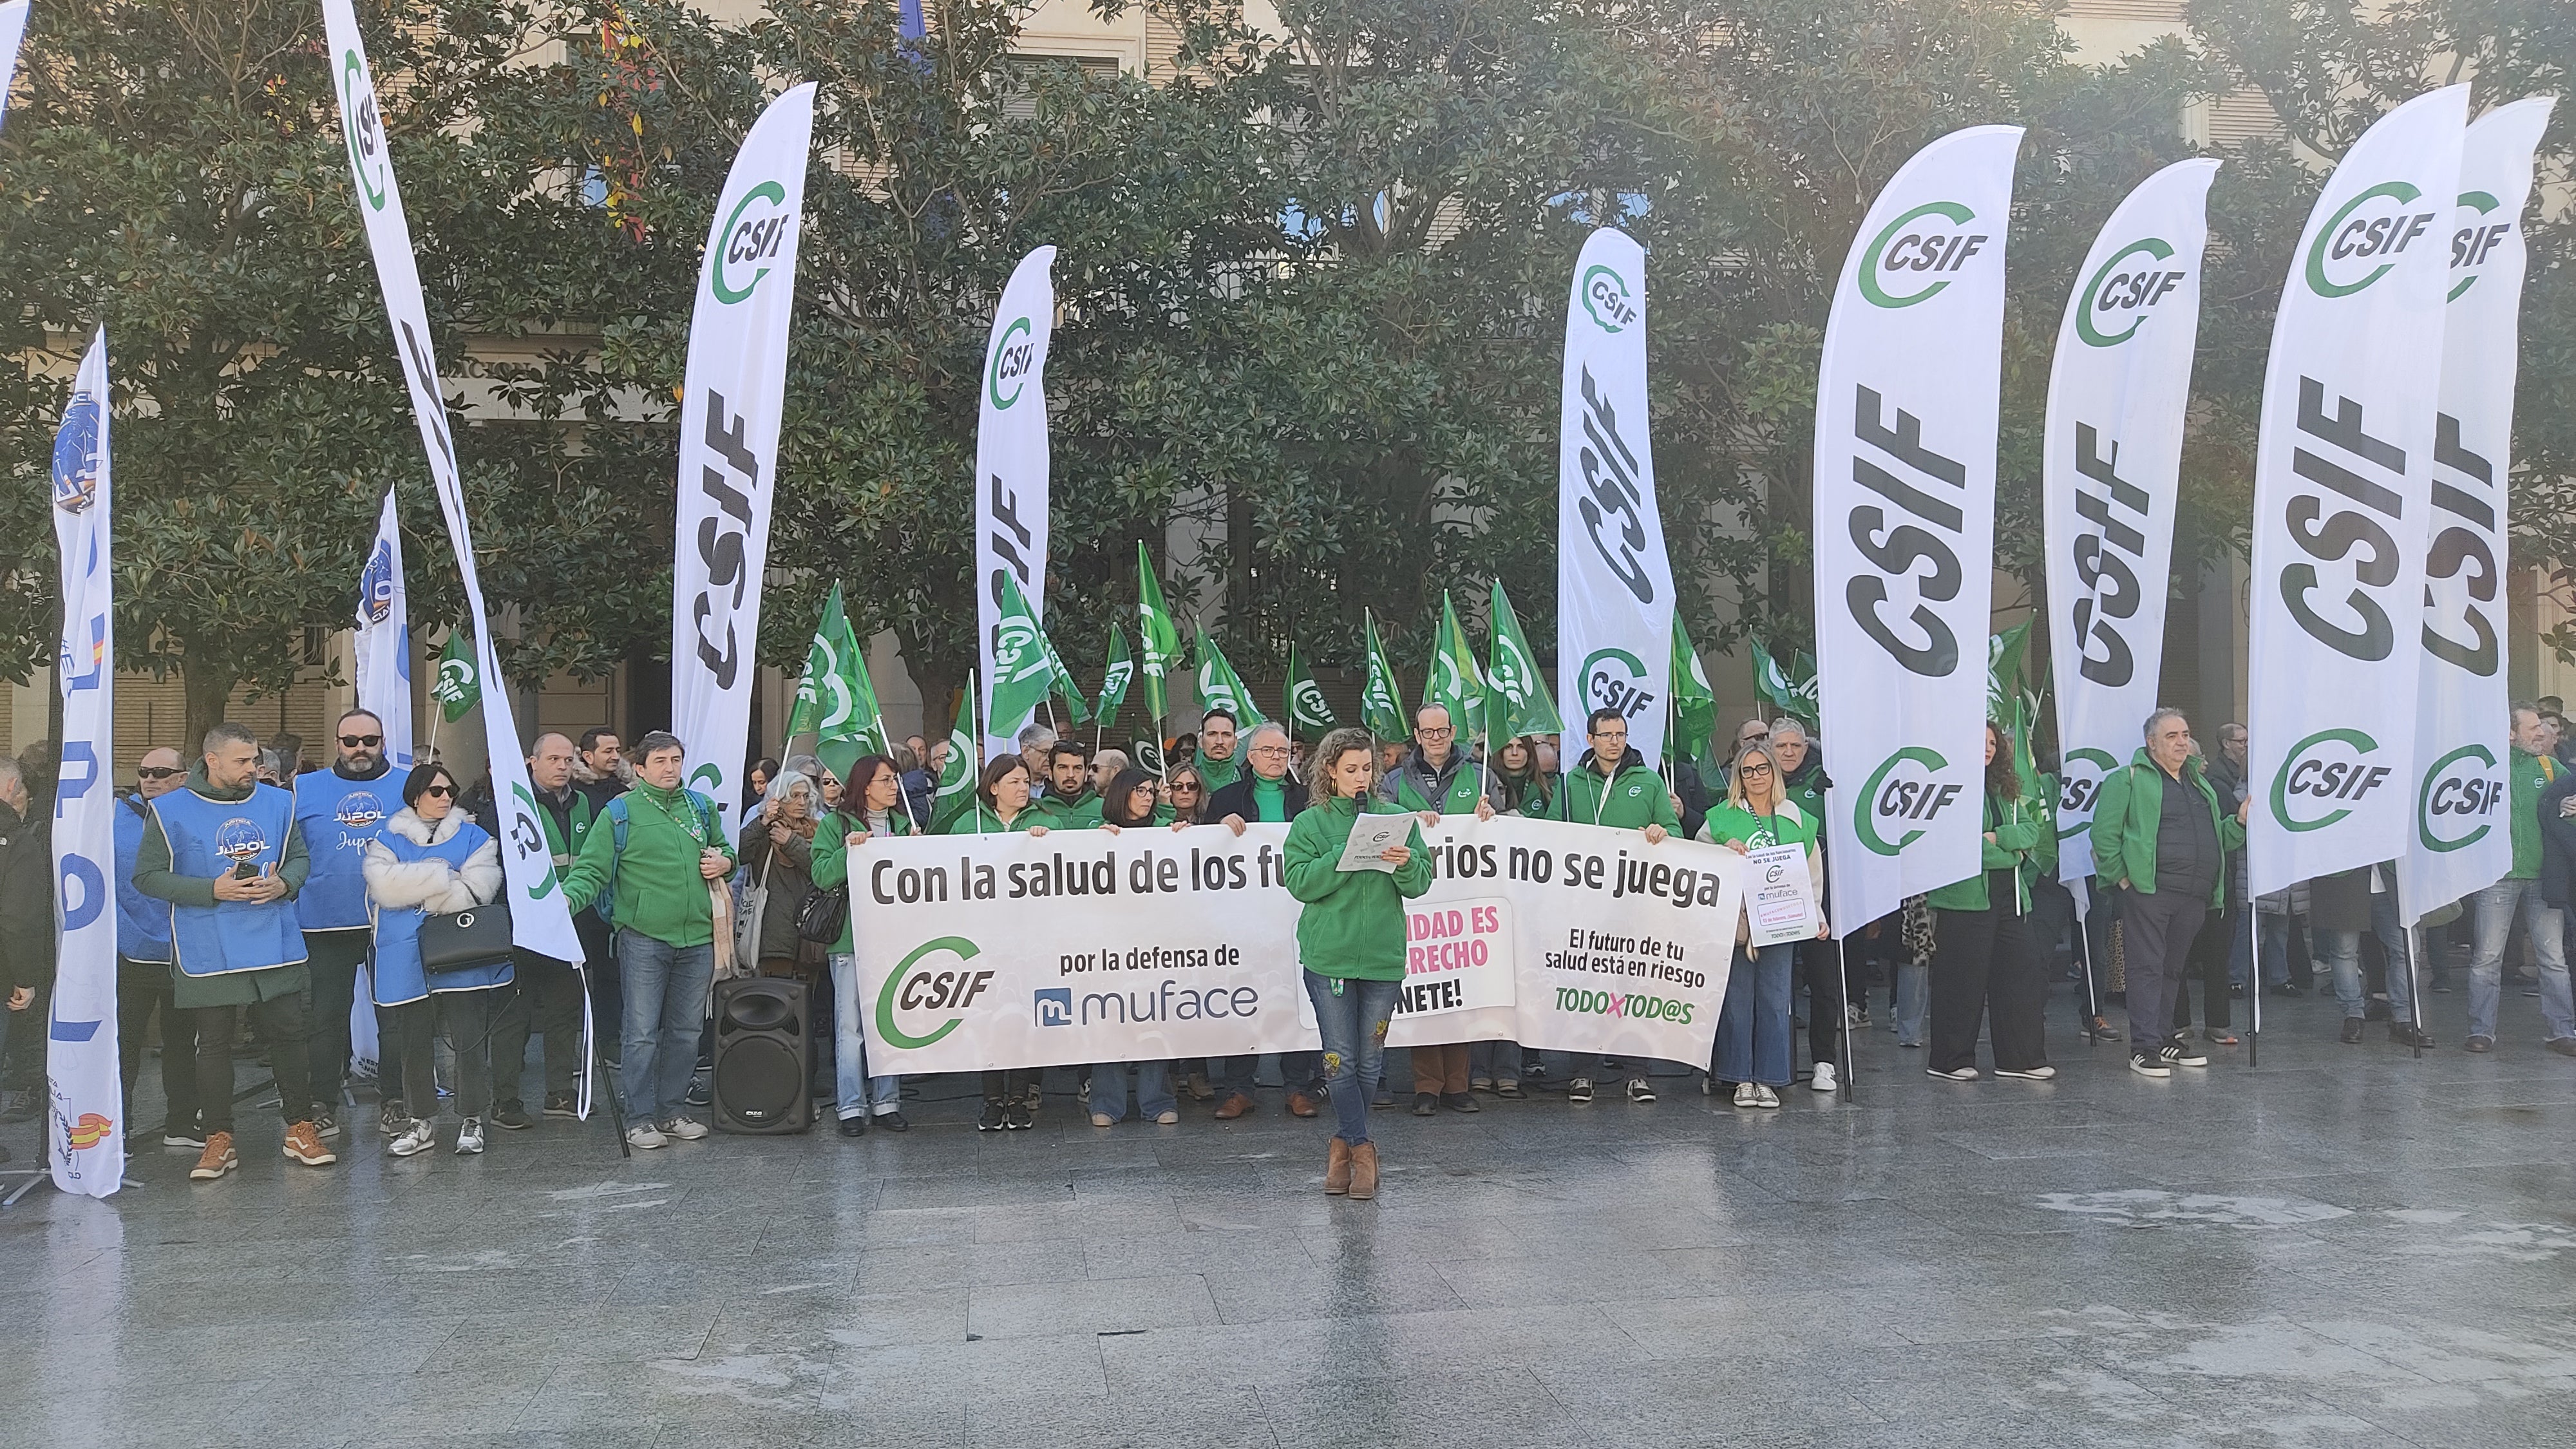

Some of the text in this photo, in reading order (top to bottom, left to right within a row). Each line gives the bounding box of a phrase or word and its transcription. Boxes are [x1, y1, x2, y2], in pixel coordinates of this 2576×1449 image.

[1885, 234, 1989, 272] CSIF
[2331, 213, 2436, 260] CSIF
[2448, 223, 2511, 269] SIF
[1591, 280, 1637, 326] CSIF
[2098, 271, 2186, 312] CSIF
[1579, 360, 1654, 605] CSIF
[1846, 382, 1965, 677] CSIF
[2278, 374, 2406, 662] CSIF
[2073, 420, 2150, 688] CSIF
[1590, 670, 1655, 721] CSIF
[1879, 779, 1963, 821] CSIF
[2061, 777, 2103, 813] SI
[2288, 759, 2392, 801] CSIF
[2430, 777, 2504, 817] CSIF
[332, 811, 386, 822] JUPOL
[214, 840, 270, 856] JUPOL
[871, 859, 947, 904] Con
[961, 857, 996, 900] la
[1009, 851, 1115, 898] salud
[1130, 850, 1179, 893] de
[1192, 848, 1247, 891] los
[1508, 852, 1553, 883] no
[1565, 857, 1606, 889] se
[1612, 849, 1720, 907] juega
[1766, 889, 1798, 900] muface
[1406, 906, 1499, 942] IDAD ES
[1569, 928, 1684, 961] El futuro de tu
[1060, 944, 1240, 976] por la defensa de
[1405, 939, 1488, 975] RECHO
[1545, 950, 1705, 989] salud está en riesgo
[900, 970, 995, 1011] CSIF
[1082, 980, 1258, 1026] muface
[1397, 979, 1463, 1015] NETE!
